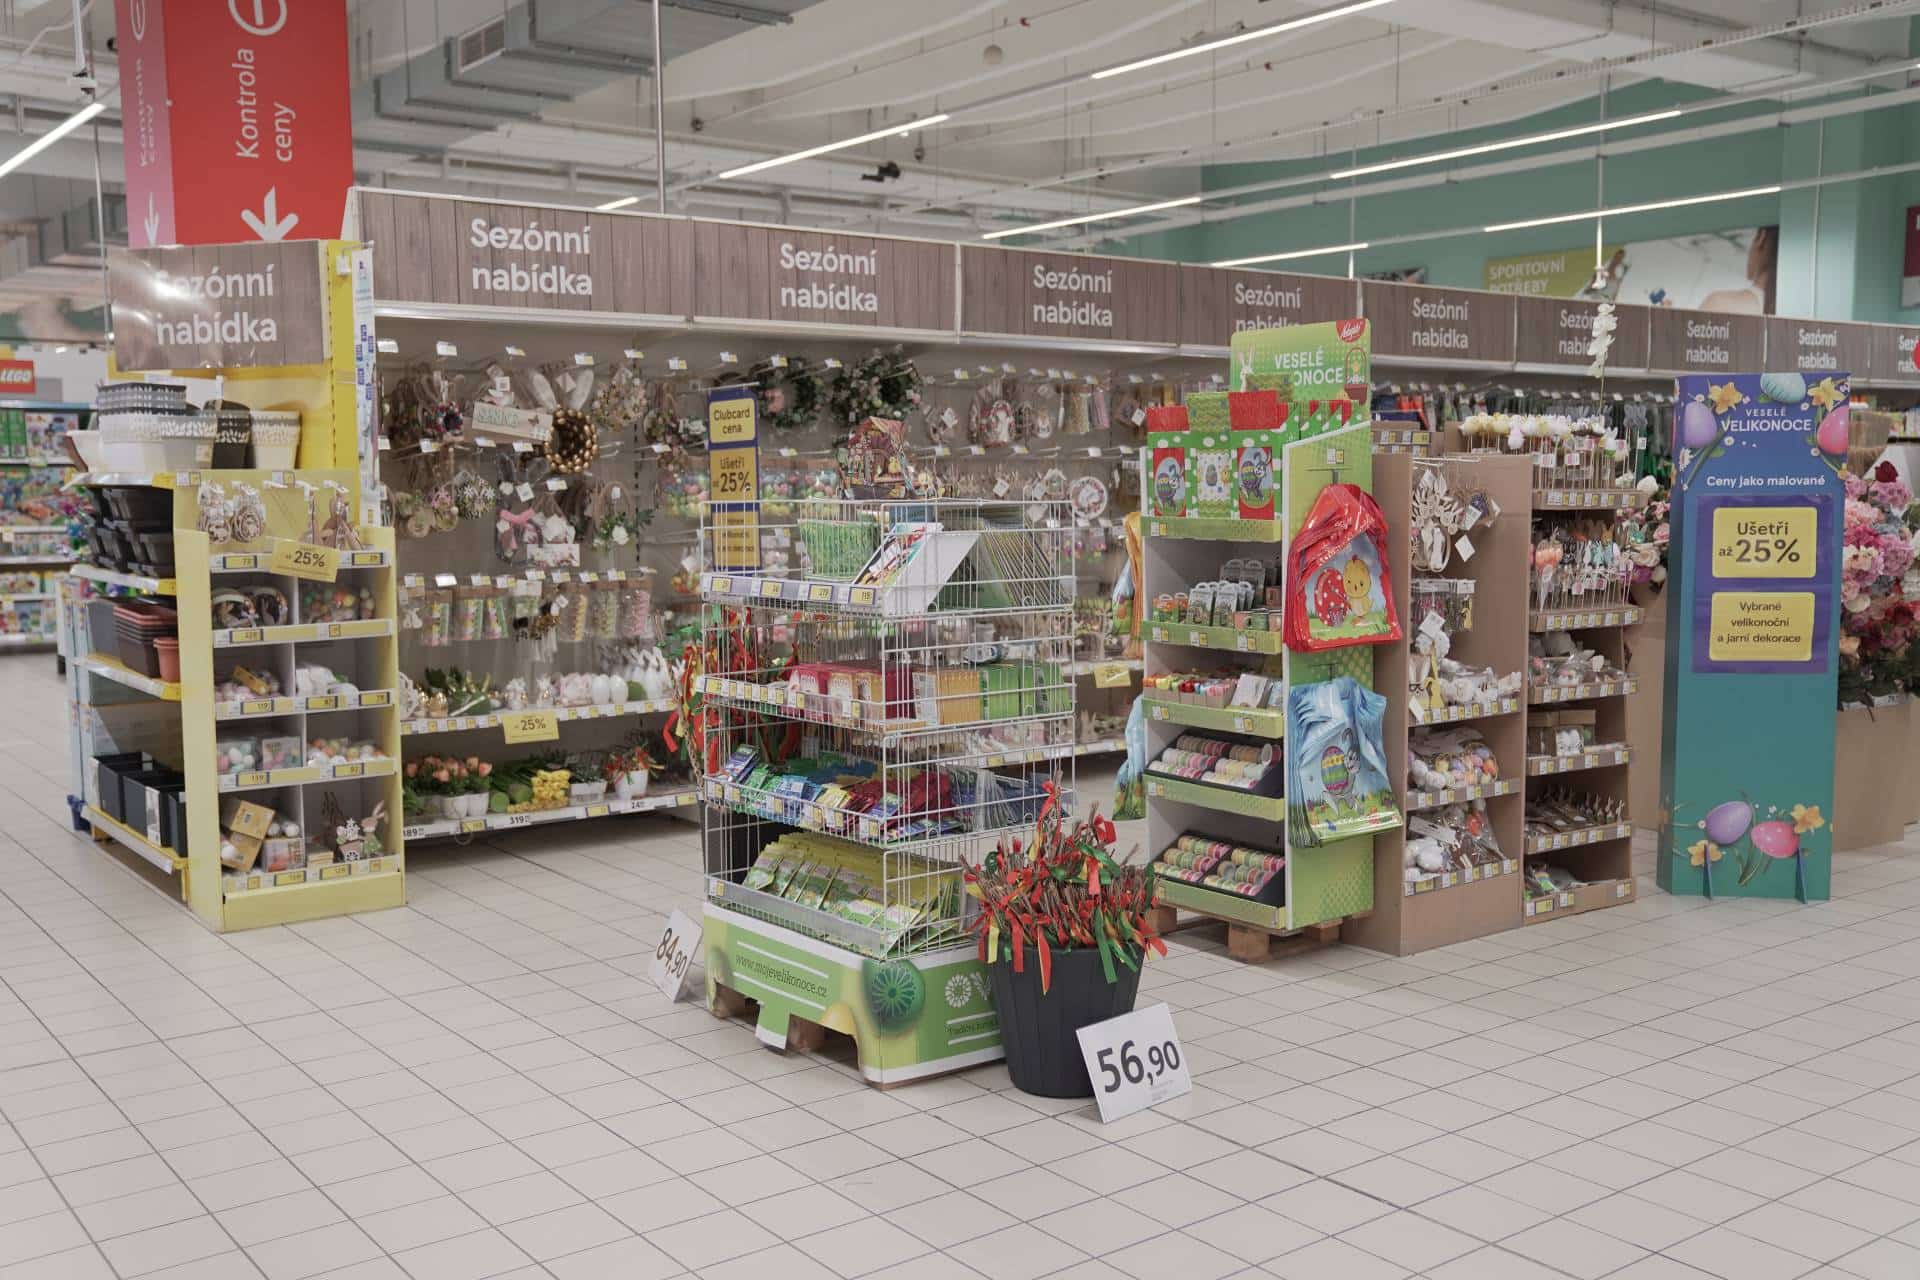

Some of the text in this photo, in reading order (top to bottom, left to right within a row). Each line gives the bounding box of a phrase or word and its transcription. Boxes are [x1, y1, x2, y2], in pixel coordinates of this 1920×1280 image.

[231, 48, 259, 159] Kontrola
[273, 102, 297, 162] ceny
[471, 218, 591, 255] Sezónní
[780, 243, 877, 276] Sezónní
[1488, 255, 1566, 281] SPORTOVNÍ
[472, 263, 593, 296] nabídka
[1033, 264, 1113, 294] Sezónní
[781, 281, 878, 313] nabídka
[1235, 282, 1302, 310] Sezónní
[1033, 300, 1113, 328] nabídka
[1412, 297, 1470, 321] Sezónní
[1560, 308, 1594, 330] Sezó
[157, 312, 277, 345] nabídka
[1412, 327, 1470, 349] nabídka
[1687, 320, 1731, 340] Sezónní
[1799, 328, 1838, 347] Sezónní
[1274, 345, 1325, 369] VESELÉ
[1559, 336, 1592, 356] nabí
[1686, 345, 1729, 364] nabídka
[1798, 351, 1838, 370] nabídka
[714, 408, 751, 421] Clubcard
[1745, 406, 1787, 417] VESELÉ
[722, 424, 743, 434] cena
[1721, 419, 1812, 432] VELIKONOCE
[720, 471, 751, 492] 25%
[1706, 474, 1826, 488] Ceny jako malované
[1737, 522, 1789, 536] Ušetři
[294, 550, 325, 567] 25%
[1718, 538, 1801, 563] až 25%
[1740, 601, 1782, 613] Vybrané
[1731, 618, 1790, 628] velikonoční
[1717, 633, 1801, 645] a jarní dekorace
[520, 718, 546, 731] 25%
[656, 927, 688, 979] 84,90
[1096, 1039, 1180, 1094] 56,90
